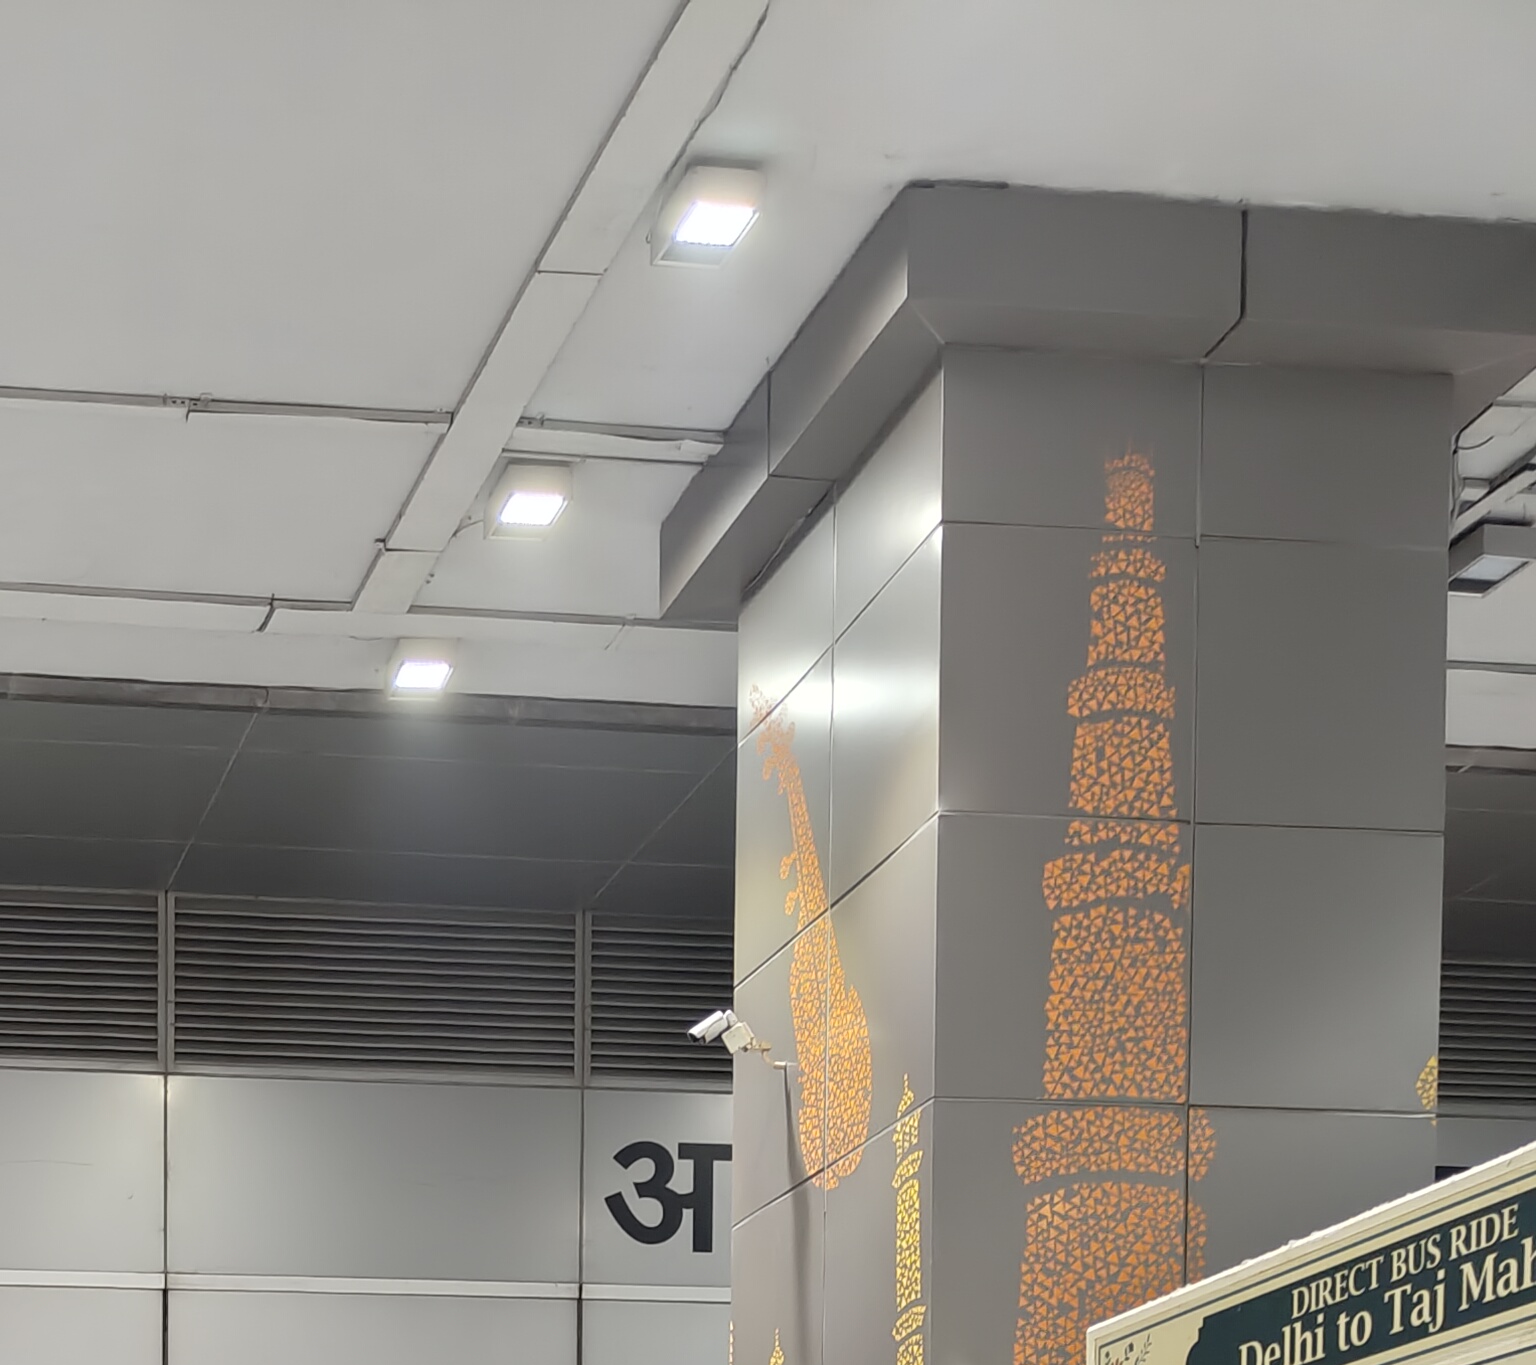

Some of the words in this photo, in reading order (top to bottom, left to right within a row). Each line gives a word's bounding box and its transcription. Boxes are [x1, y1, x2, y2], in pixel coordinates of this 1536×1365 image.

[604, 1140, 733, 1253] अ
[1291, 1257, 1384, 1320] DIRECT
[1390, 1233, 1441, 1280] BUS
[1449, 1203, 1520, 1261] RIDE
[1336, 1308, 1373, 1351] to
[1383, 1269, 1446, 1334] Taj
